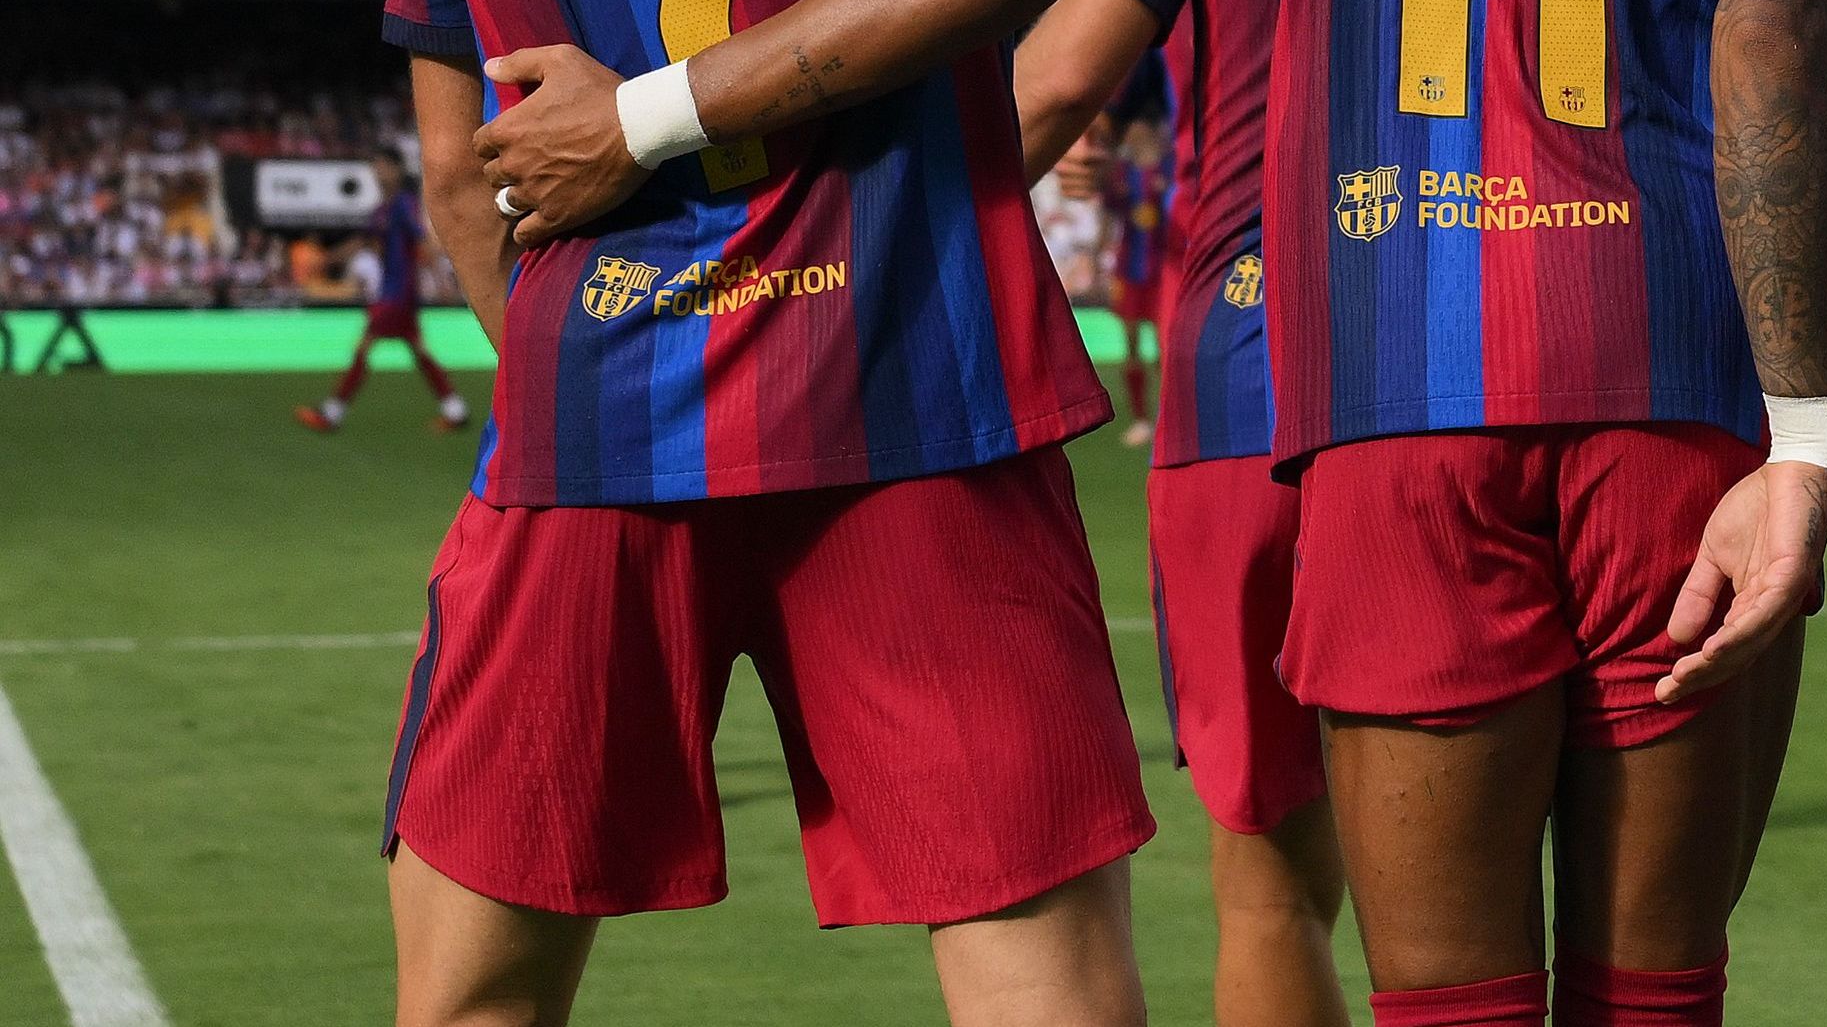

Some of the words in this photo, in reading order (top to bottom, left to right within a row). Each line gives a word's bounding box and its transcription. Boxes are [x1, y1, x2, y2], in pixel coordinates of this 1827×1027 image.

[1357, 197, 1382, 209] FCB
[1419, 170, 1528, 206] BARÇA
[1418, 200, 1630, 231] FOUNDATION
[653, 261, 846, 316] FOUNDATION
